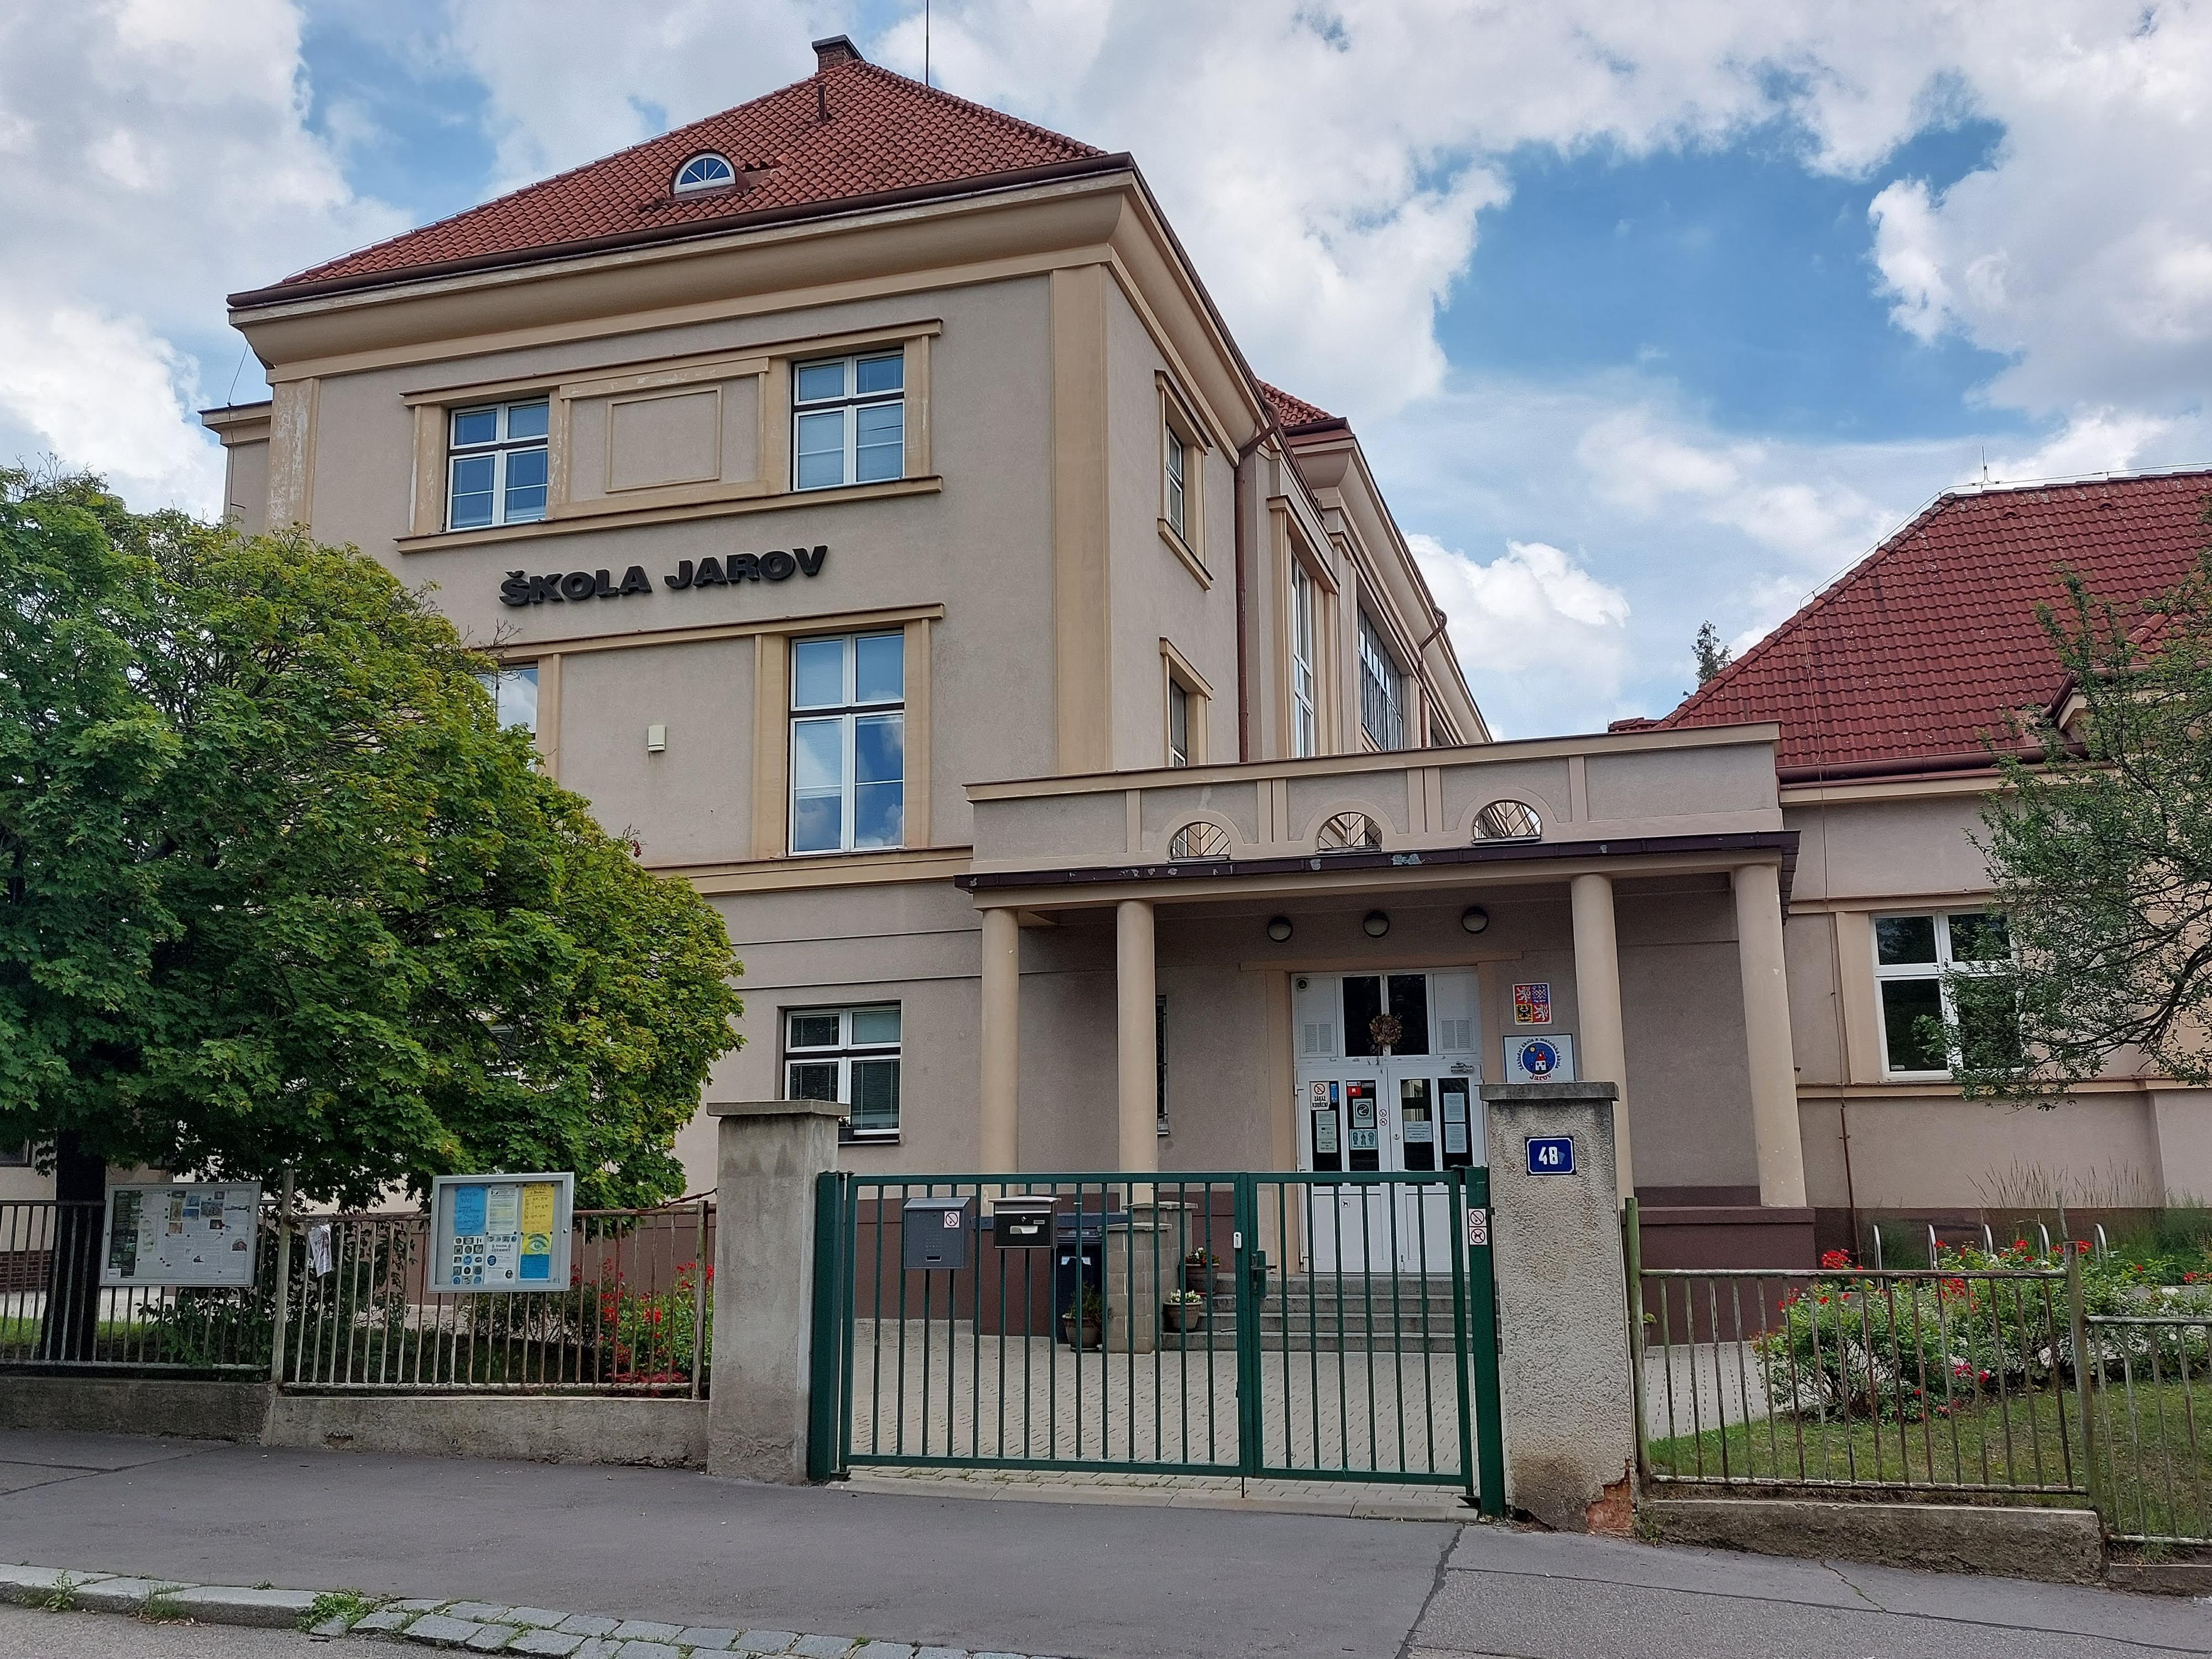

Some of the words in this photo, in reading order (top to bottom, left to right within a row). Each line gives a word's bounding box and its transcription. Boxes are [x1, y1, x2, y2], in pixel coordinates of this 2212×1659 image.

[499, 565, 653, 607] ŠKOLA
[664, 545, 828, 589] JAROV
[1539, 1146, 1558, 1165] 48
